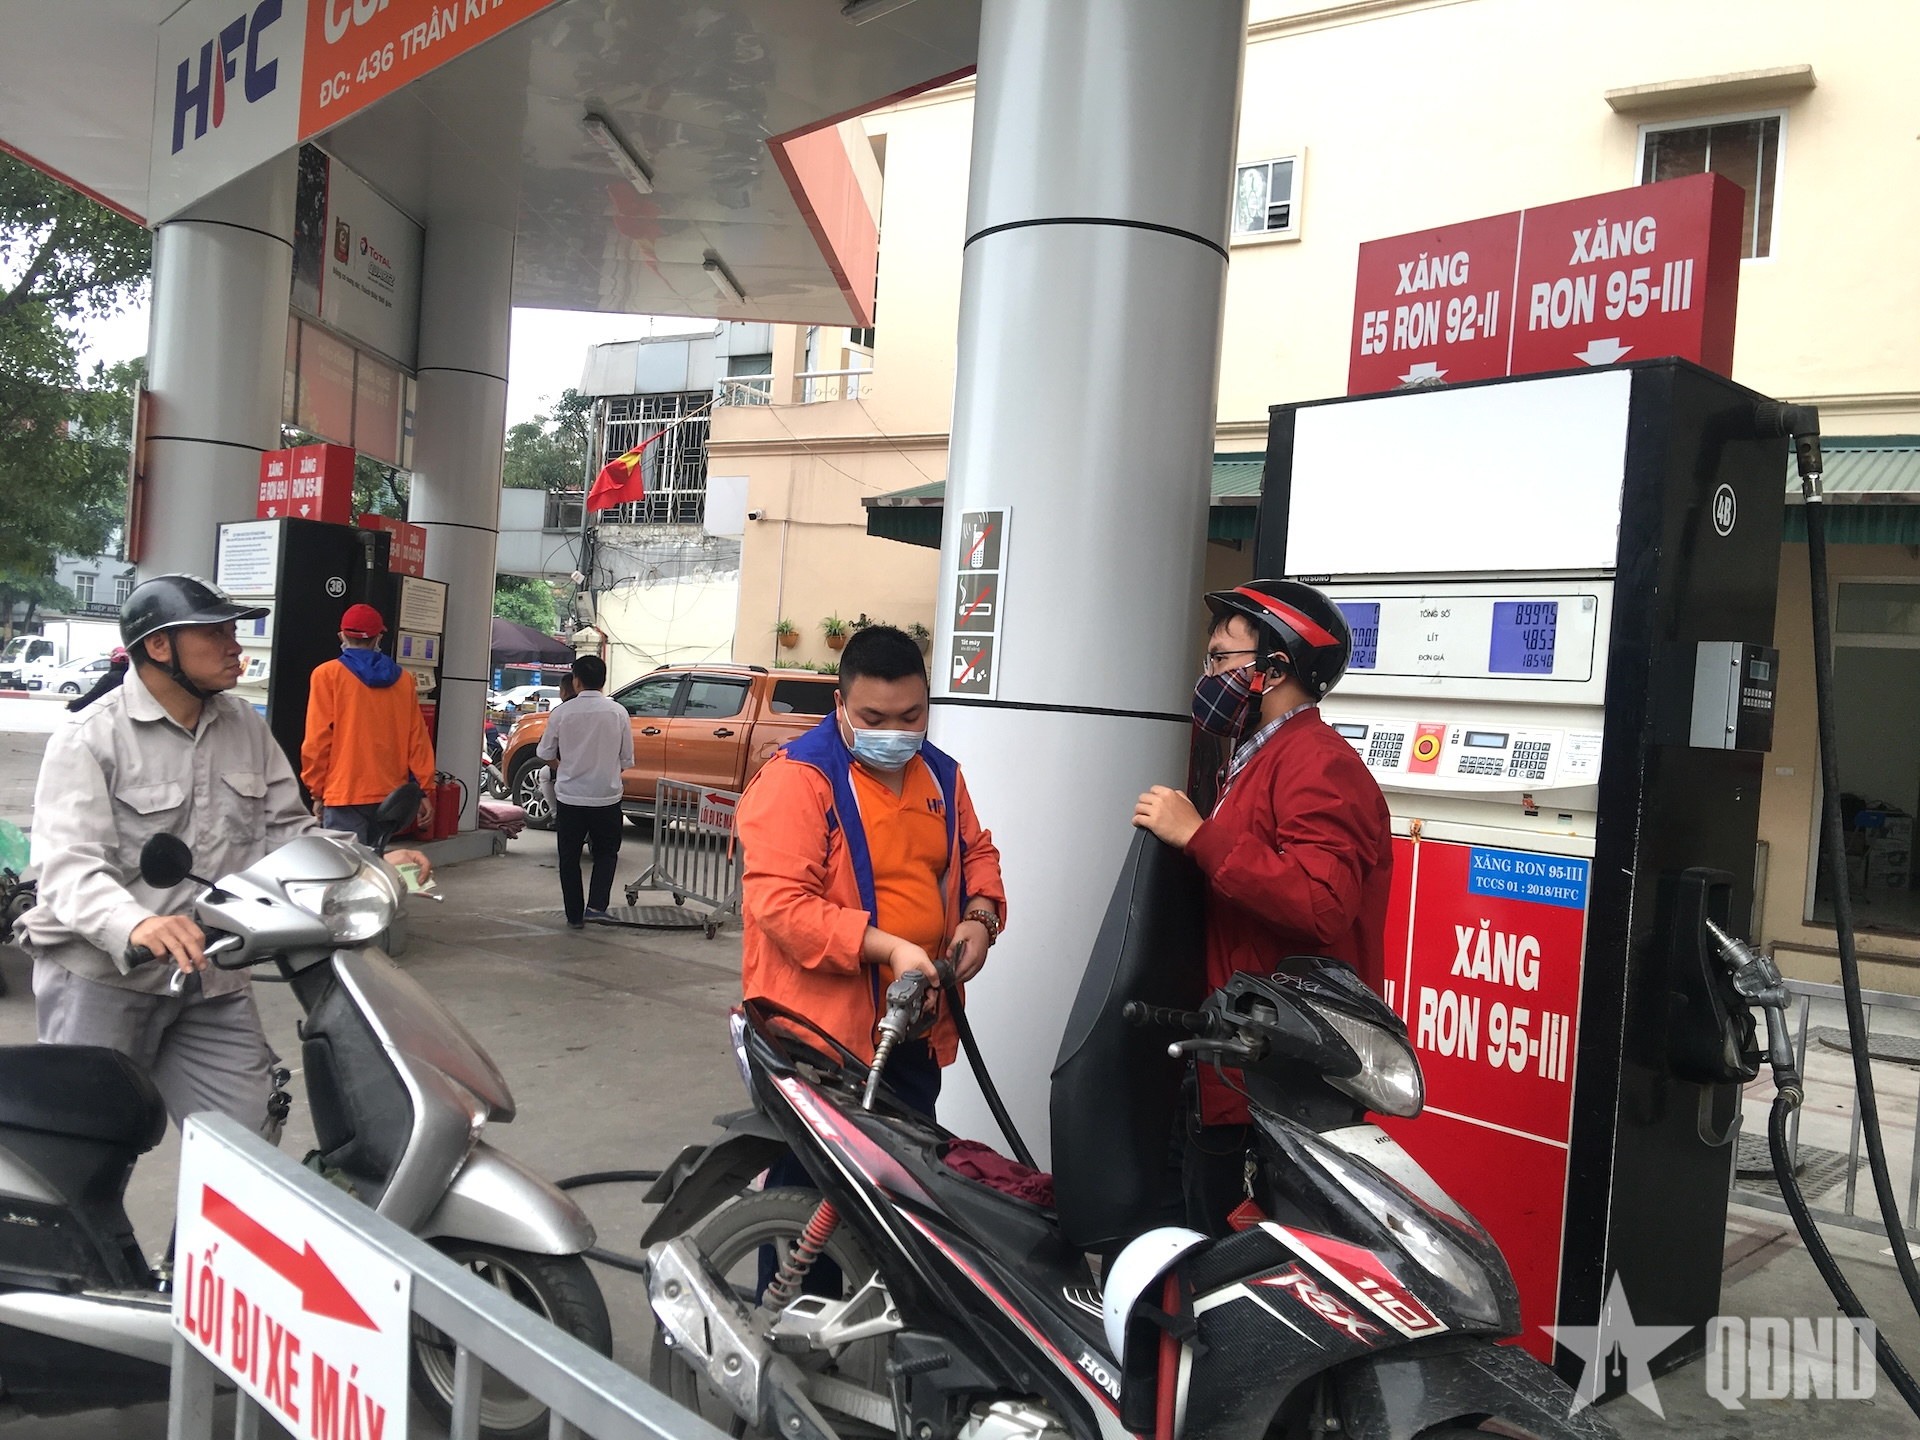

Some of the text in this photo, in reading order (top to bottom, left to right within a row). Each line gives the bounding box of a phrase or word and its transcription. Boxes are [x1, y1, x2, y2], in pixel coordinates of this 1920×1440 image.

[172, 0, 283, 156] HFC
[319, 71, 351, 109] ĐC:
[356, 42, 394, 84] 436
[400, 2, 459, 60] TRẦN
[1568, 217, 1658, 266] XĂNG
[1395, 251, 1470, 296] XĂNG
[1528, 258, 1695, 332] RON 95-III
[1360, 290, 1500, 356] E5 RON 92-II
[268, 460, 283, 477] XĂNG
[292, 478, 305, 498] RON
[300, 456, 317, 474] XĂNG
[1717, 494, 1732, 527] 4B
[330, 580, 343, 593] 3B
[1474, 854, 1511, 873] XĂNG
[1515, 861, 1546, 876] RON
[1476, 876, 1504, 890] TCCS
[1507, 881, 1518, 892] 01
[1527, 884, 1579, 900] 2018/HFC
[1451, 918, 1541, 992] XĂNG
[1417, 986, 1570, 1083] RON 95-III
[1356, 1275, 1429, 1328] 110
[184, 1242, 386, 1440] LỐI ĐI XE MÁY
